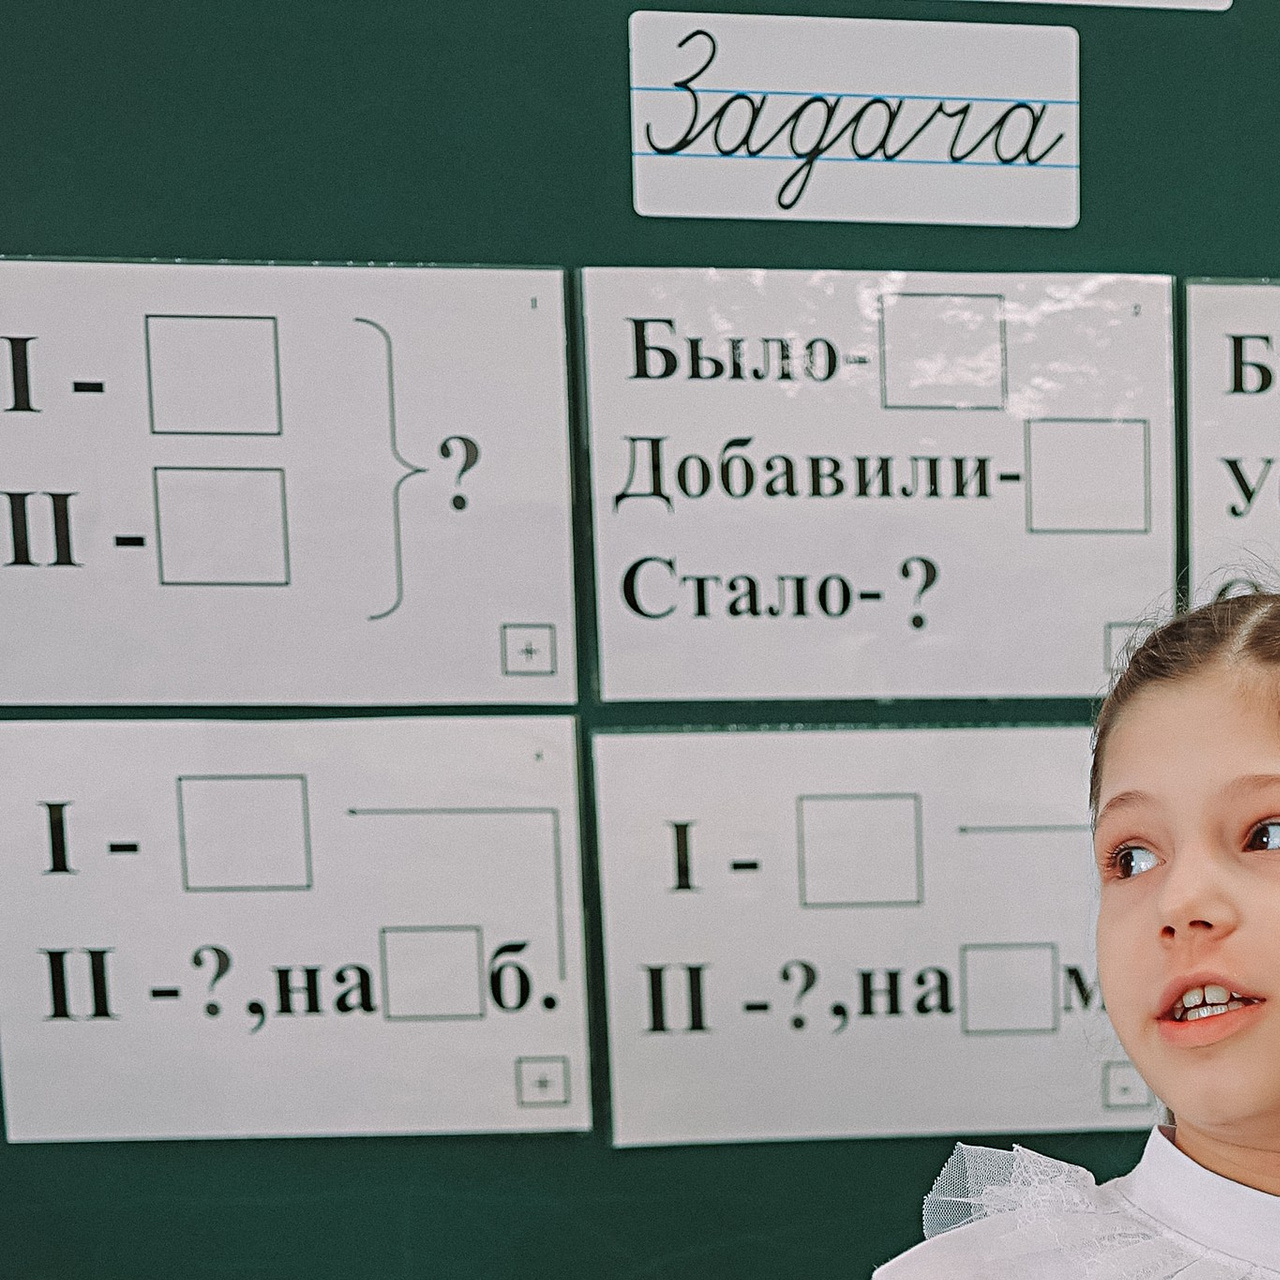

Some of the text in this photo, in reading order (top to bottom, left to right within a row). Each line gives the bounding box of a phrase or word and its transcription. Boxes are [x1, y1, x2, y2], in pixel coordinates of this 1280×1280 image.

[646, 29, 1065, 209] Задача
[626, 316, 871, 384] Было-
[613, 435, 1022, 512] Добавили-
